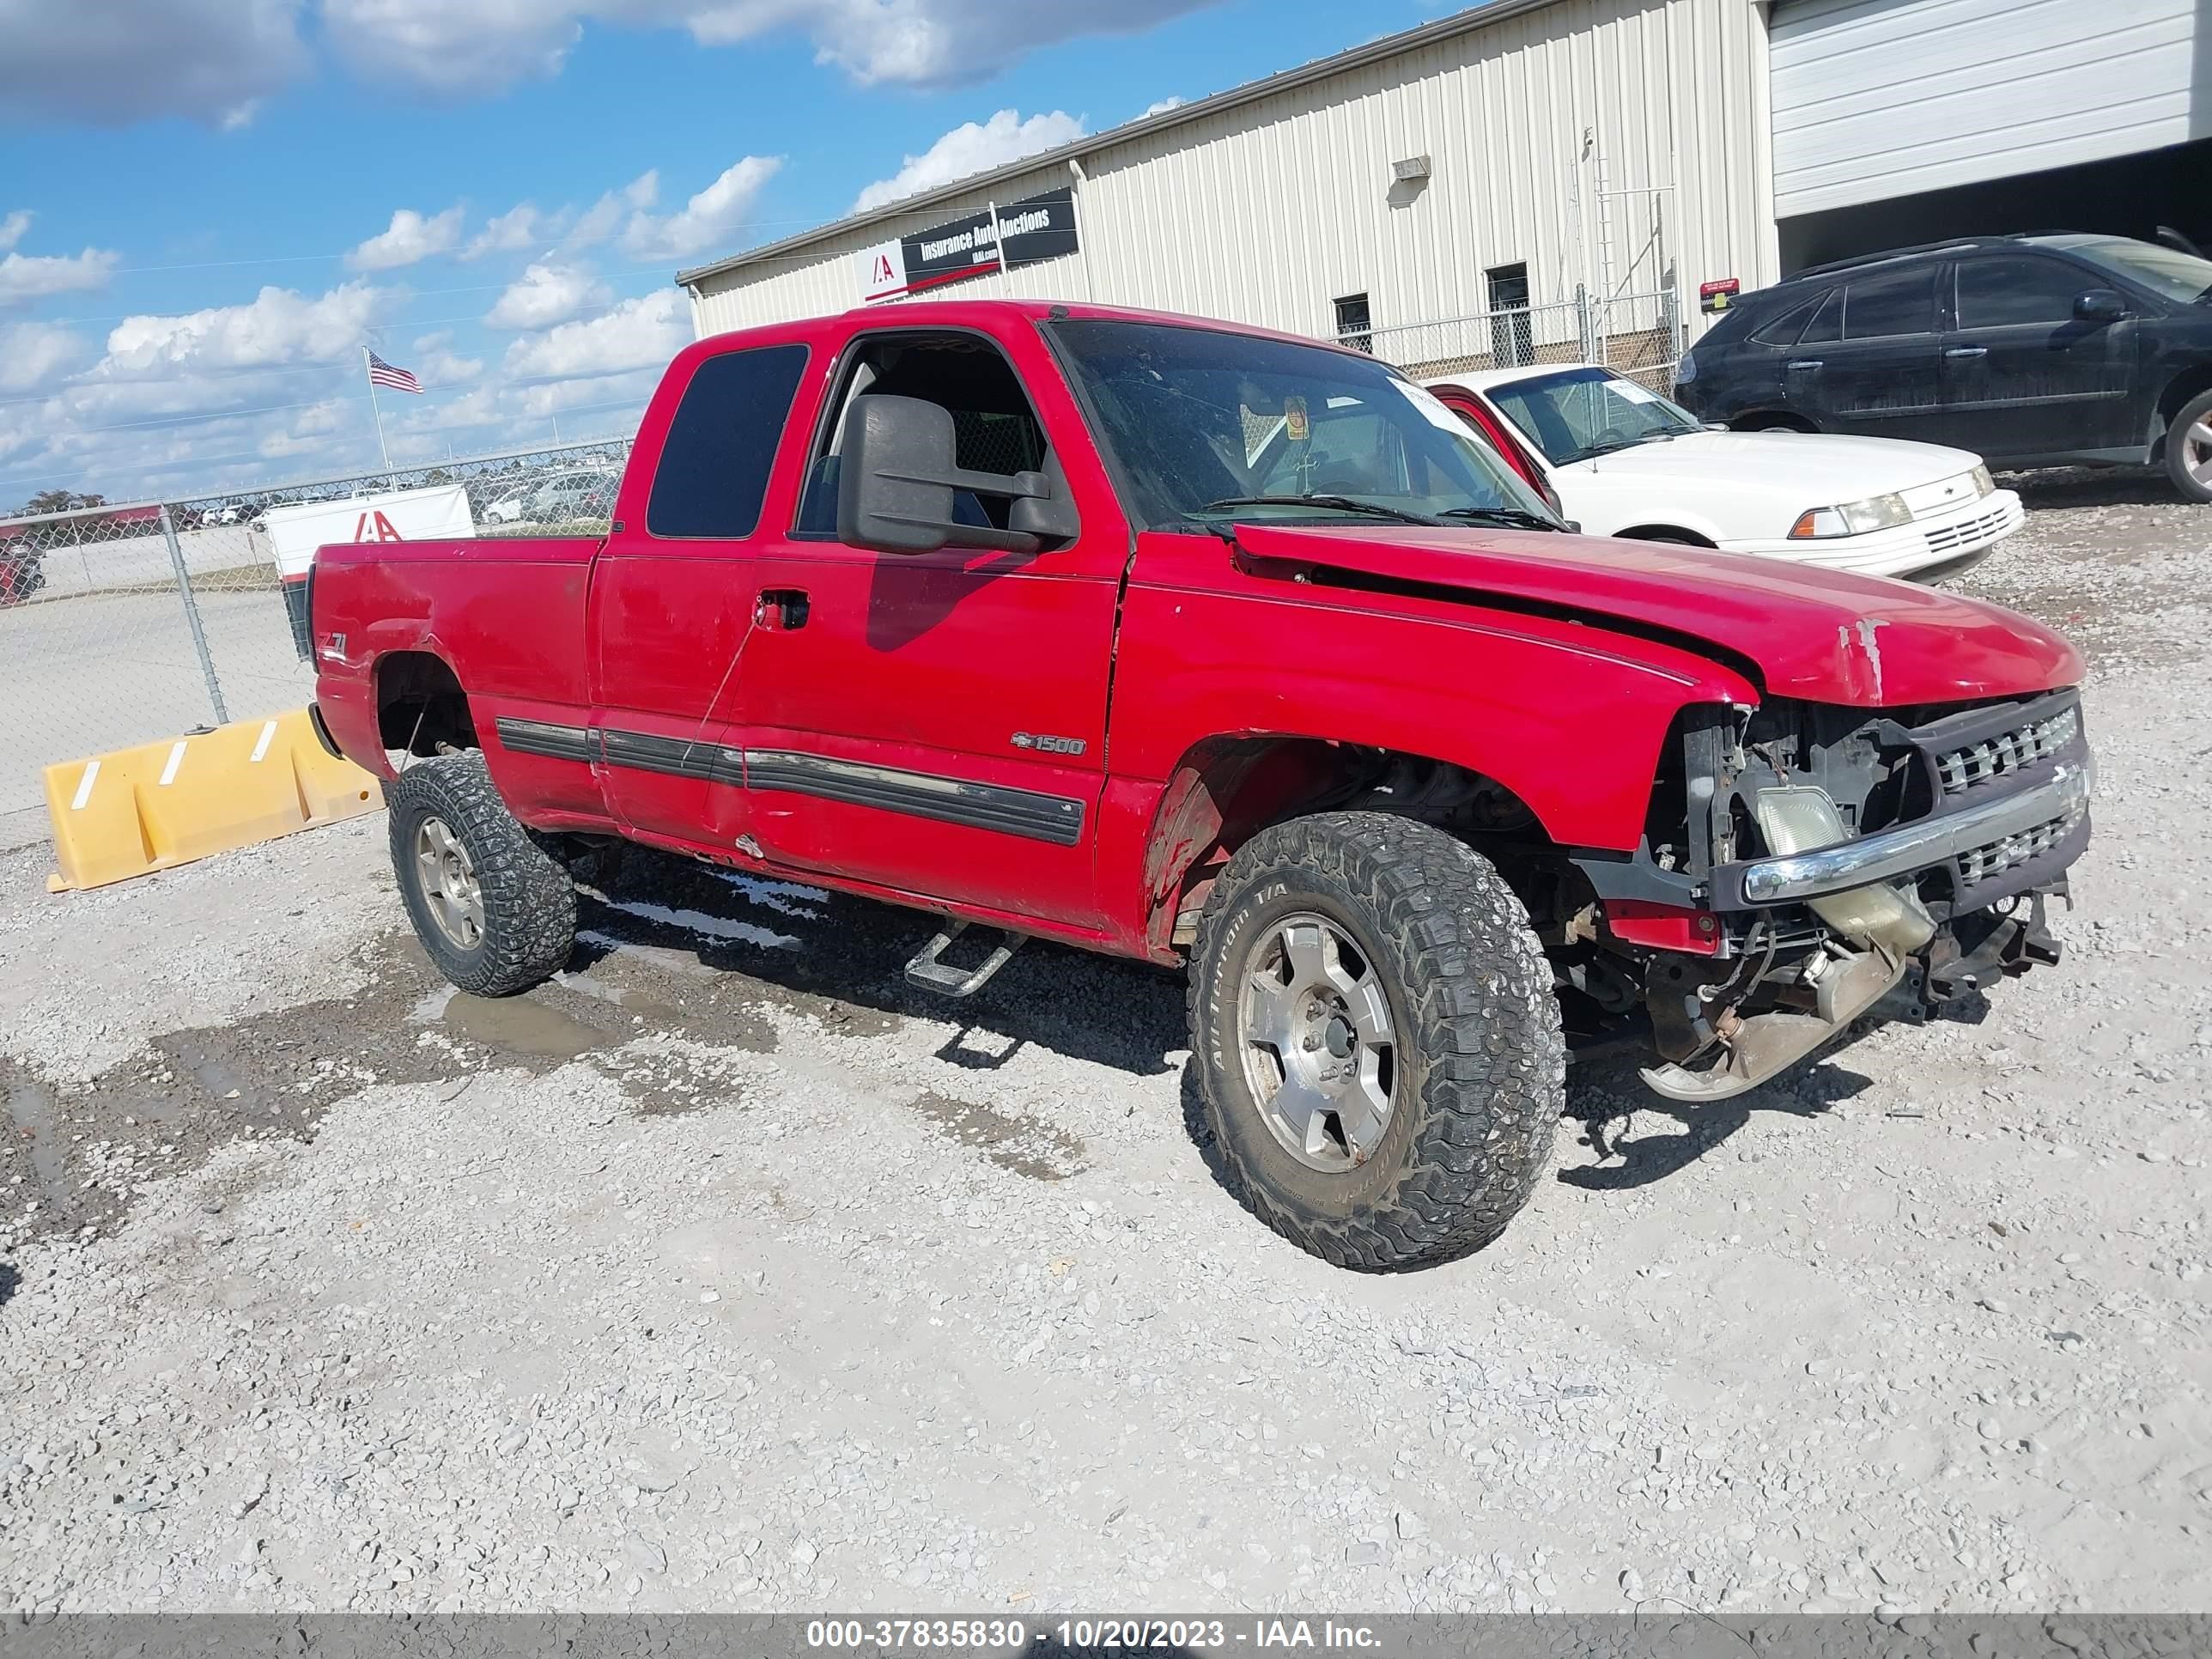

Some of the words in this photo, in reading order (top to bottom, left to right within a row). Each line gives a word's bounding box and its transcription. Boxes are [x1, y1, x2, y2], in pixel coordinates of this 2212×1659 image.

[921, 231, 973, 261] Insurance
[973, 223, 999, 247] Auto
[999, 208, 1050, 240] Auctions
[319, 631, 347, 656] Z71
[1036, 737, 1084, 755] 1500
[1209, 908, 1251, 1072] All-Terrain
[1254, 883, 1289, 906] T/A
